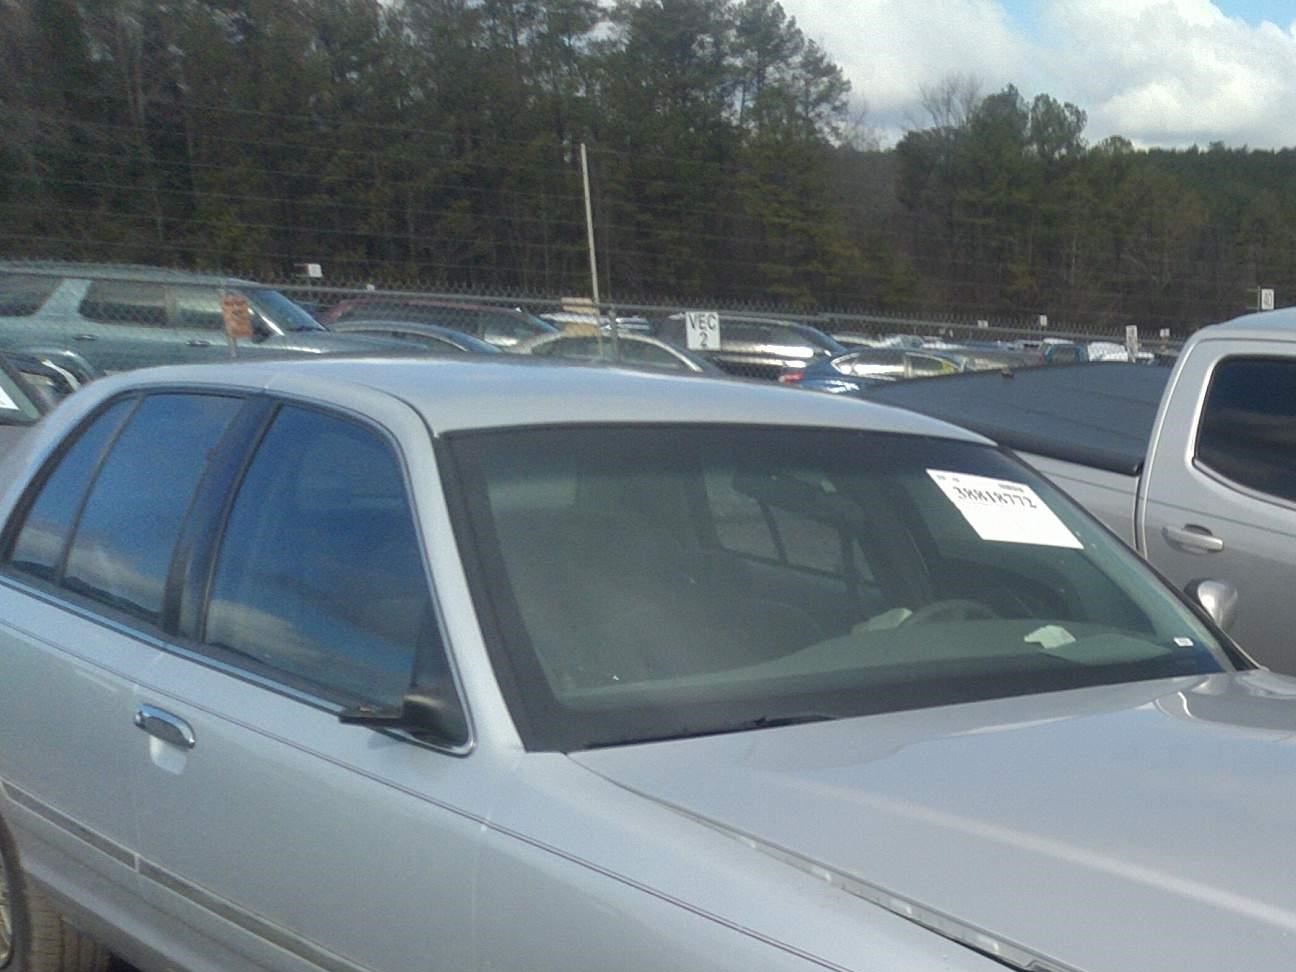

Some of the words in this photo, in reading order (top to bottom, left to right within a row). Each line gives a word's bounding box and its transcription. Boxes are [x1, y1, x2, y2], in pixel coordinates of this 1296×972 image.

[688, 313, 717, 330] VEC
[699, 331, 708, 347] 2
[952, 485, 1038, 509] 38818772
